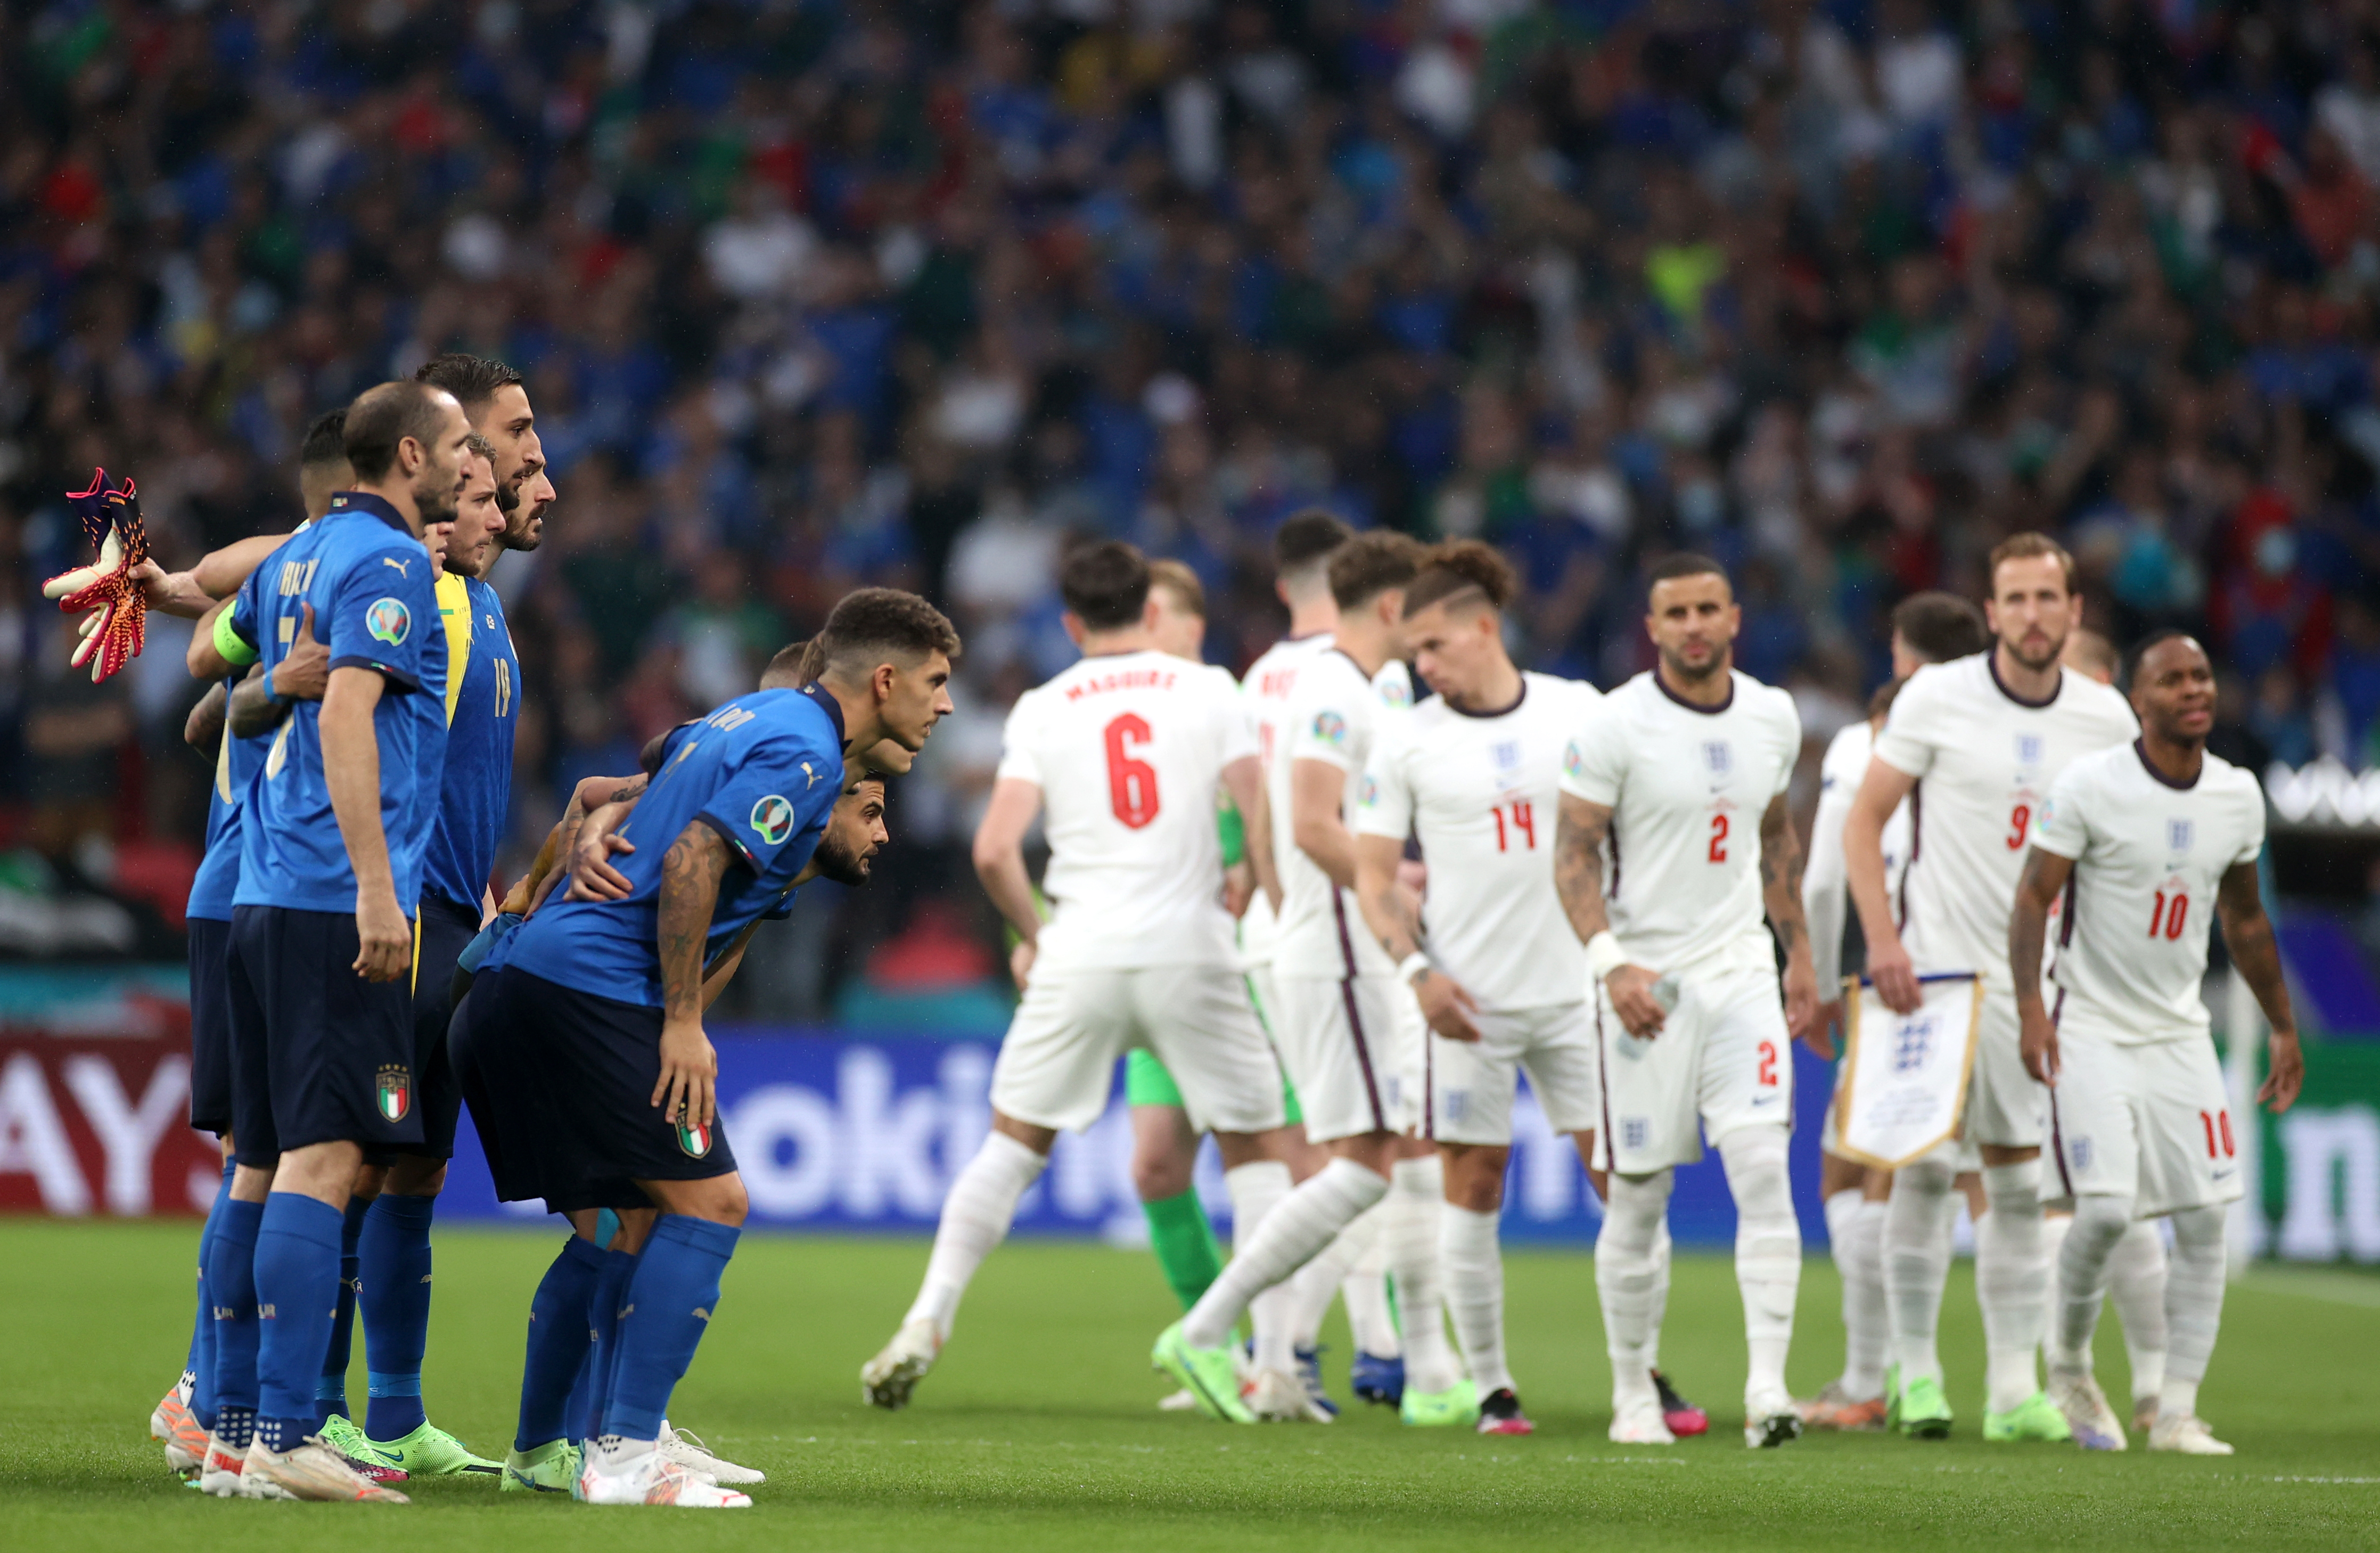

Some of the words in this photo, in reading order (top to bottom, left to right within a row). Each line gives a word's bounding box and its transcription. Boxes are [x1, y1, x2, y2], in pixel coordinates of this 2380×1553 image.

[494, 658, 511, 717] 19
[1064, 669, 1177, 703] MAGUIRE
[1104, 712, 1160, 829] 6
[1490, 800, 1536, 853] 14
[1708, 813, 1728, 863] 2
[2006, 803, 2030, 851] 9
[2148, 889, 2189, 942] 10
[1758, 1040, 1777, 1086] 2
[0, 1051, 219, 1217] AY
[2200, 1109, 2235, 1159] 10
